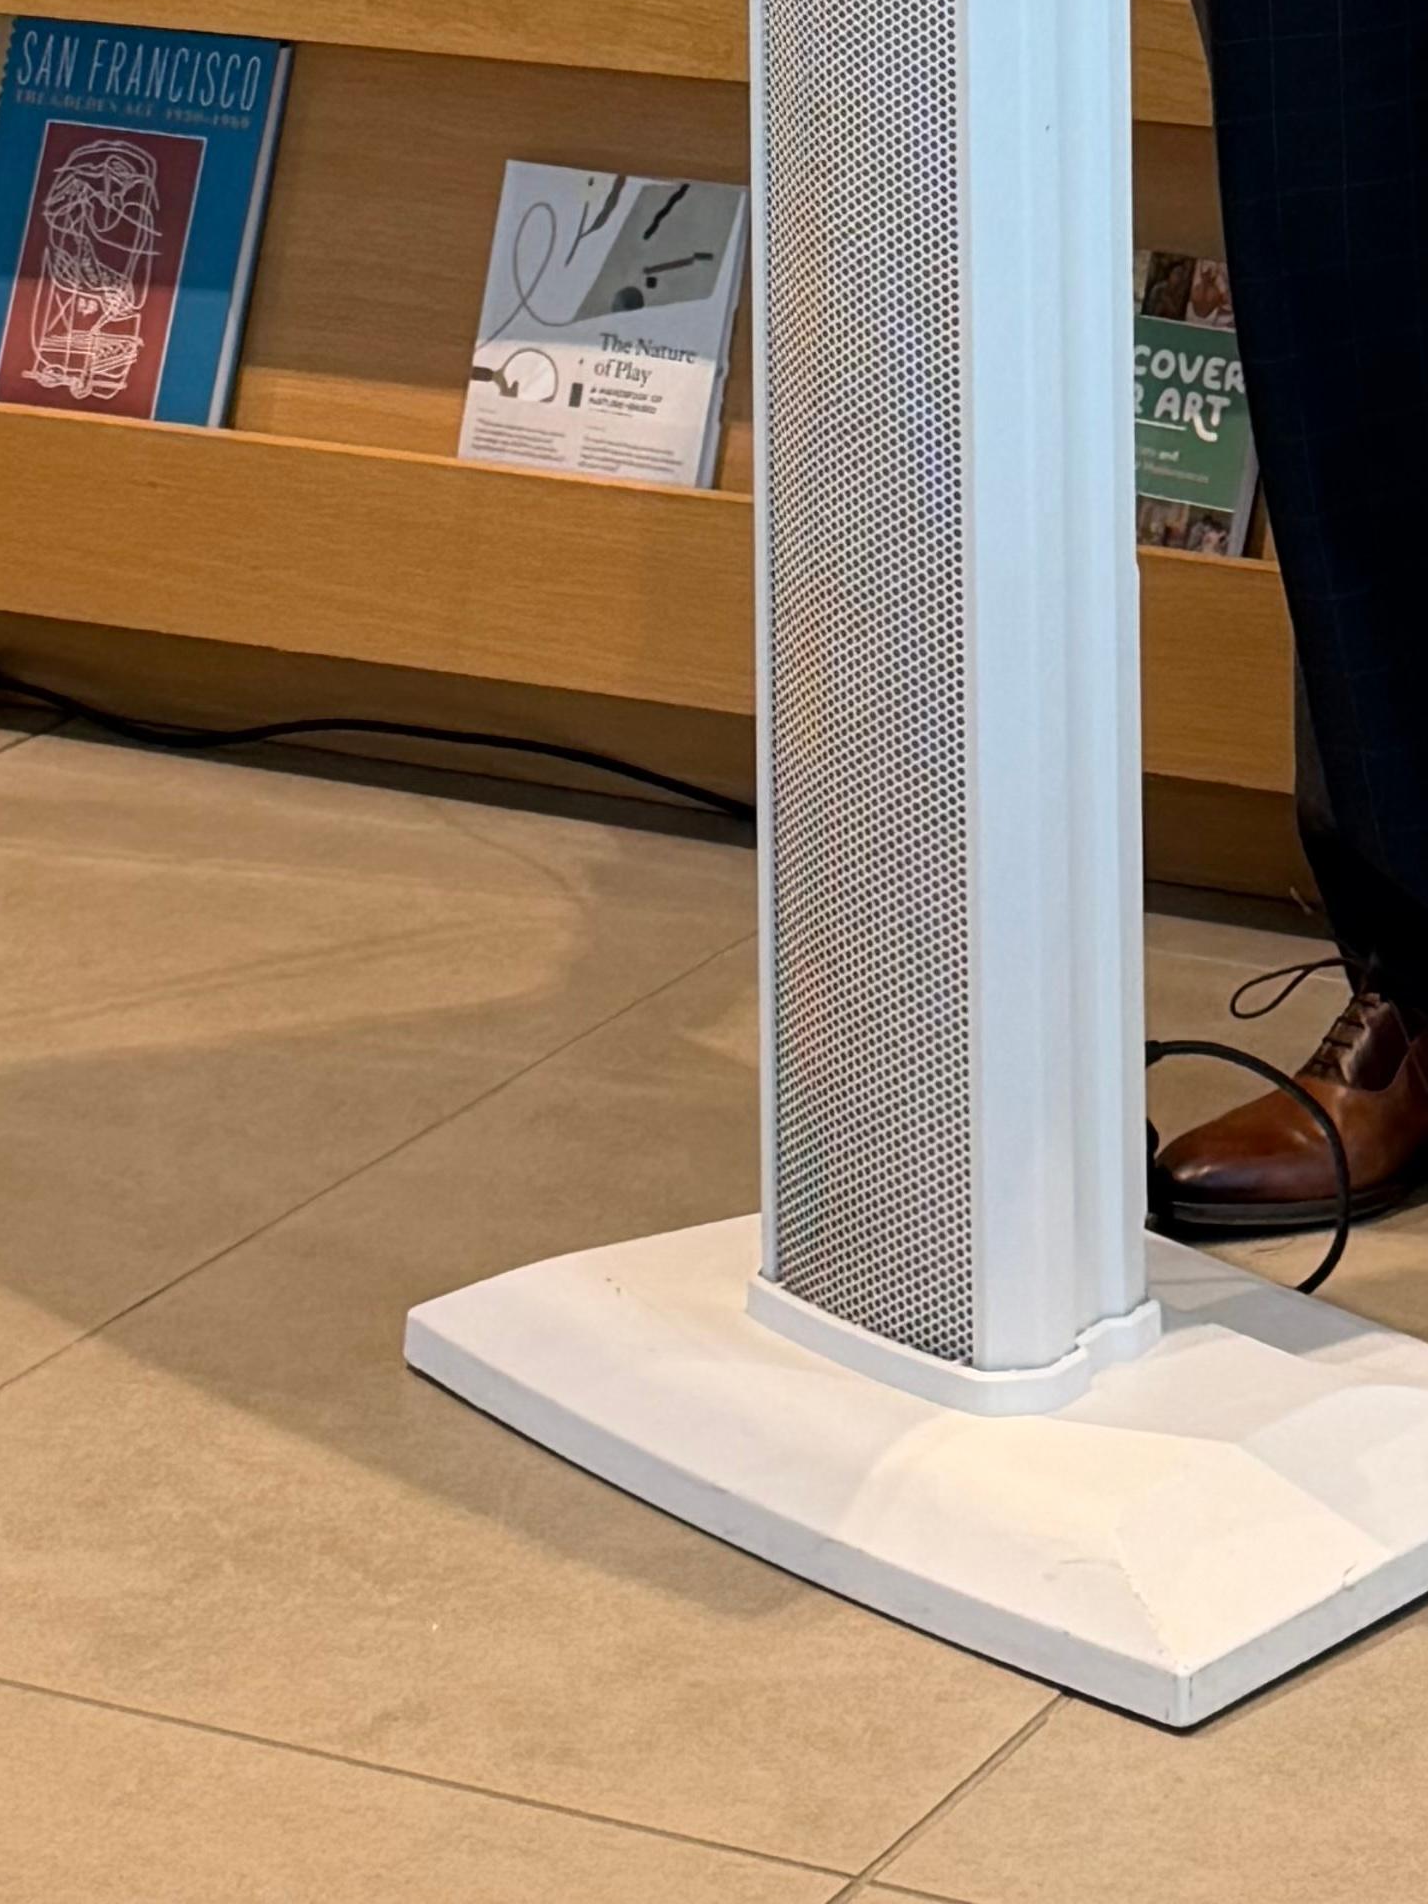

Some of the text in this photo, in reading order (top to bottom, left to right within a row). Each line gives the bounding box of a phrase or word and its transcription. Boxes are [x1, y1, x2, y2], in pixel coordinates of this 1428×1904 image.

[16, 30, 79, 88] SAN
[87, 39, 262, 111] FRANCISCO
[600, 332, 698, 364] The Nature
[1135, 344, 1246, 394] COVER
[615, 360, 652, 388] Play
[1154, 387, 1232, 442] ART
